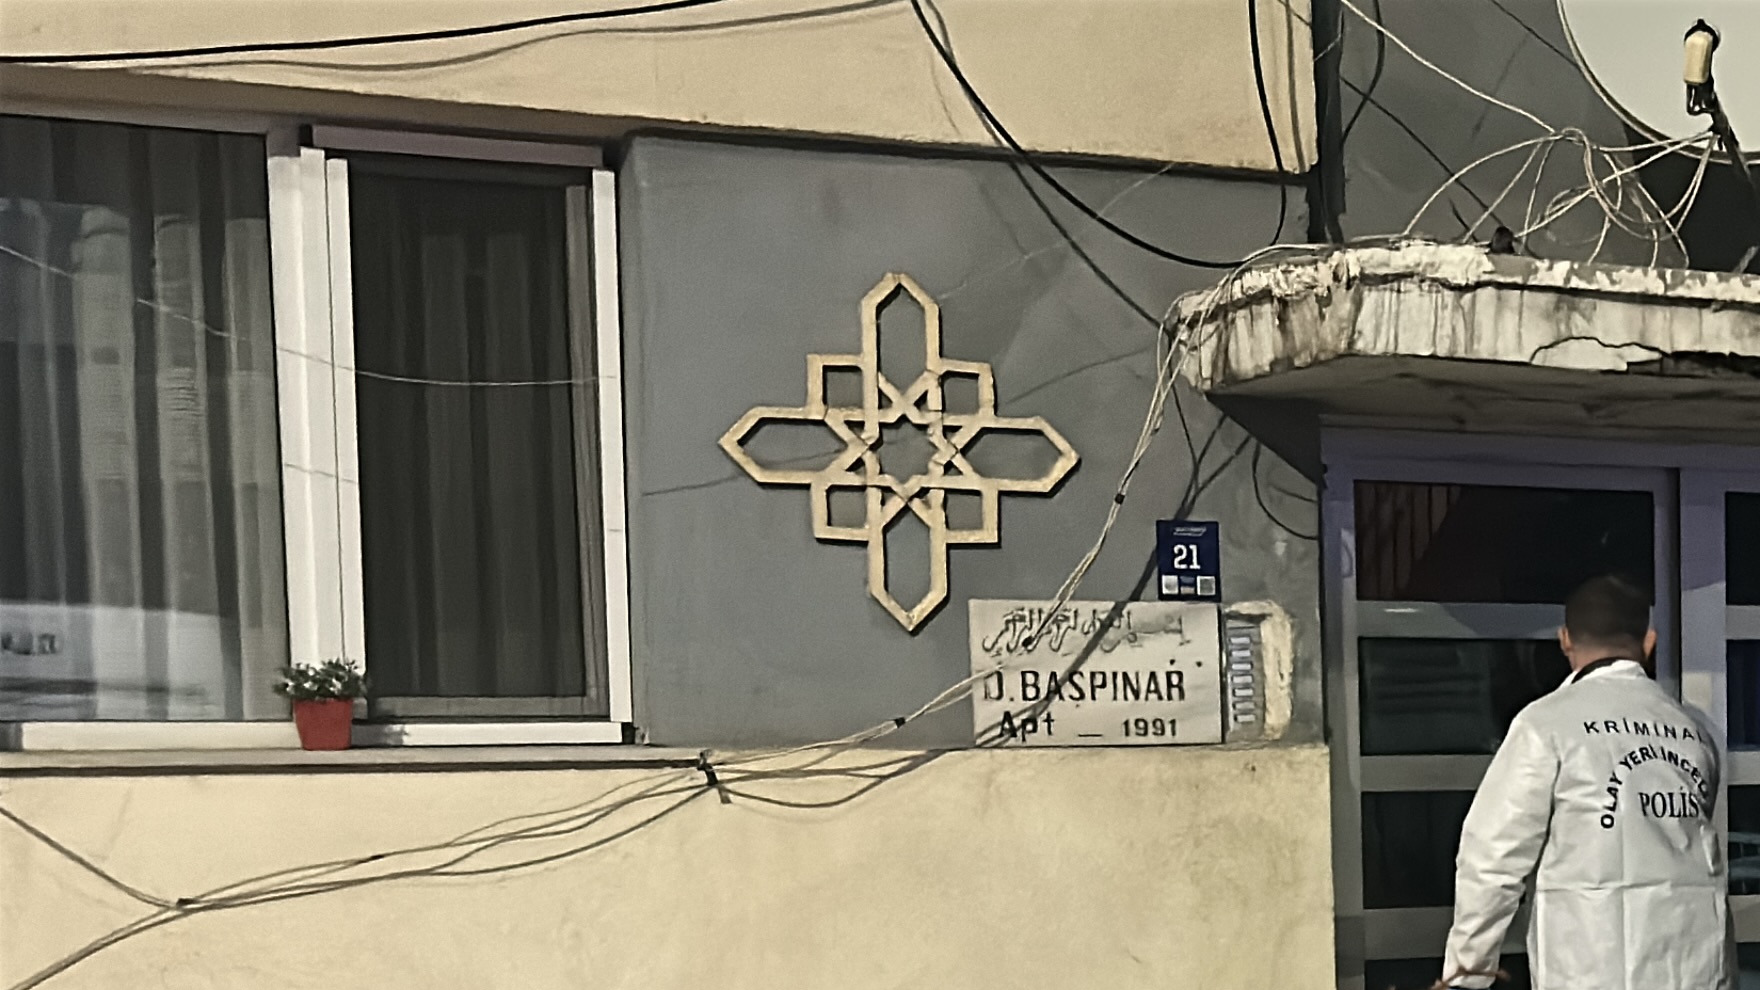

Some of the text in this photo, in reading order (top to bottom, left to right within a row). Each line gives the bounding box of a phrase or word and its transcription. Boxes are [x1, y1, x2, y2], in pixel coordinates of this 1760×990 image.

[1173, 544, 1201, 569] 21
[1000, 711, 1055, 742] Apt
[1123, 718, 1177, 737] 1991
[1600, 771, 1624, 829] OLAY
